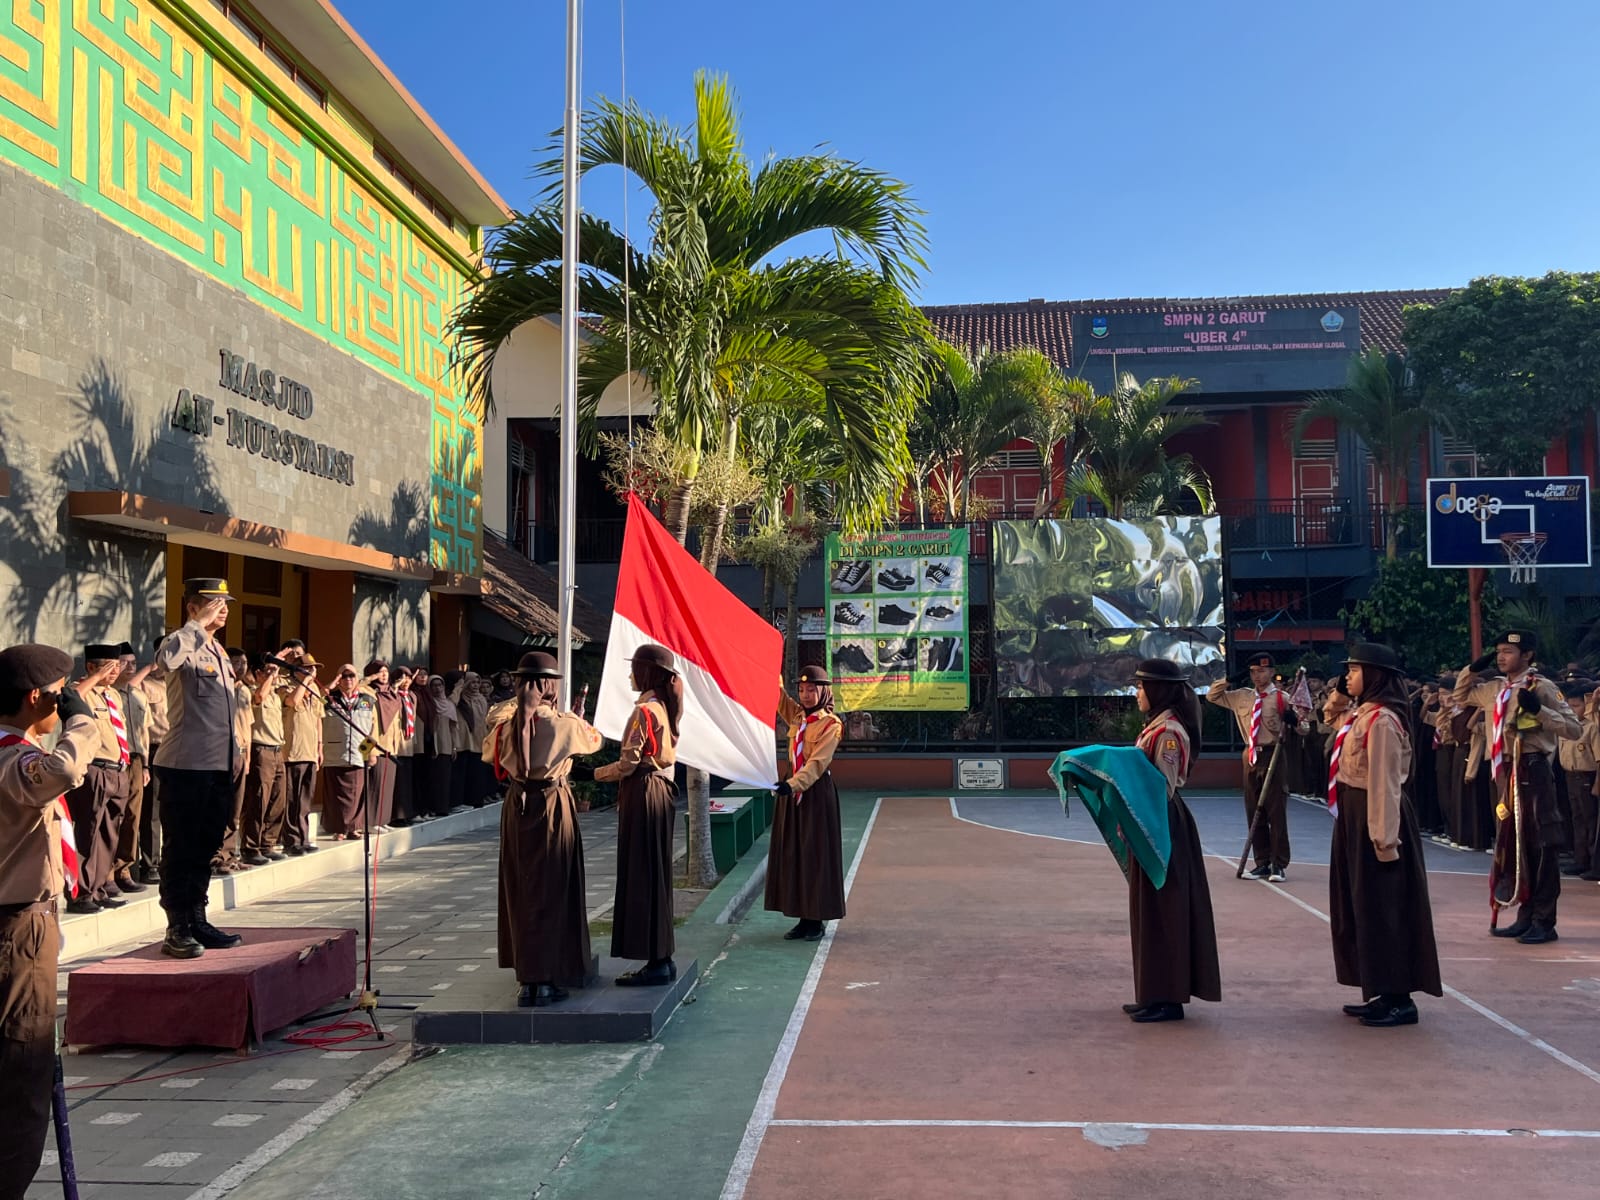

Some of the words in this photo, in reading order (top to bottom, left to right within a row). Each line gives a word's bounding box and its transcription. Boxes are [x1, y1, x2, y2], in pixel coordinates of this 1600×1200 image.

[1163, 313, 1203, 326] SMPN
[1207, 313, 1215, 325] 2
[1219, 311, 1267, 325] GARUT
[219, 348, 314, 421] MASJID
[840, 545, 854, 557] DI
[857, 544, 893, 557] SMPN
[896, 543, 905, 556] 2
[908, 541, 952, 556] GARUT
